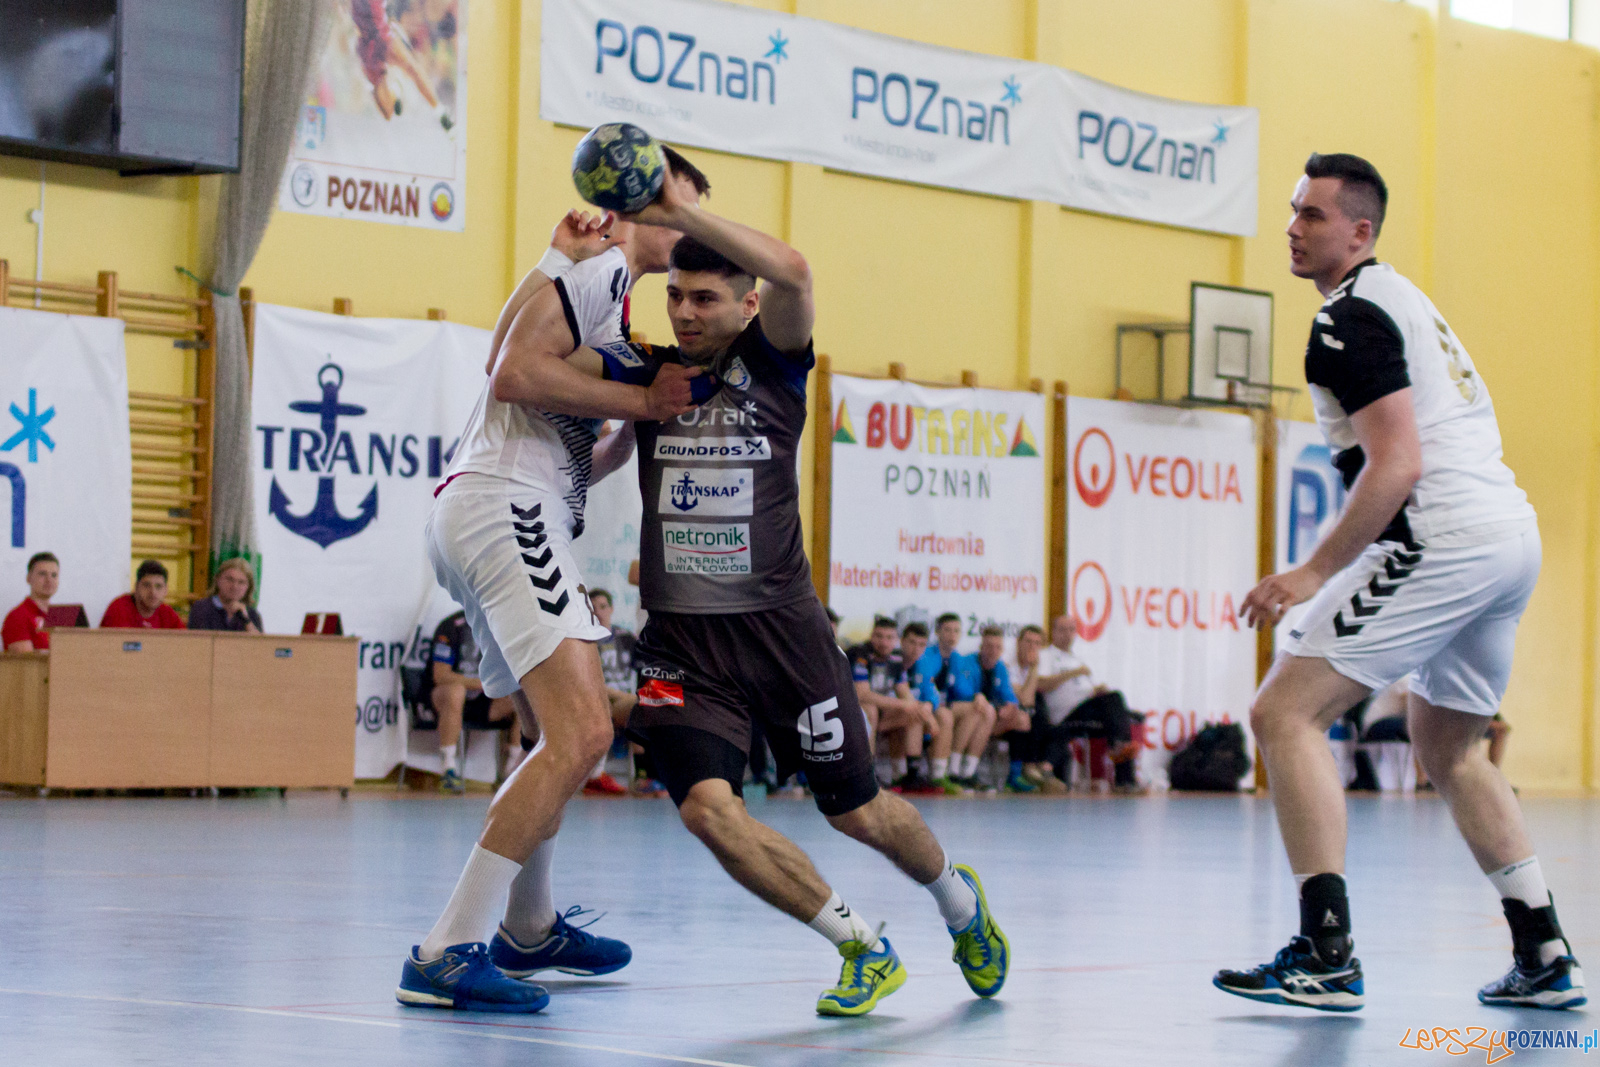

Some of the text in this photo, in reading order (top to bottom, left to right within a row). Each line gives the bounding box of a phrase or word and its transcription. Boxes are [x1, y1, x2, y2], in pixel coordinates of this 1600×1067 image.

[327, 175, 420, 219] POZNAŃ
[865, 402, 1008, 458] BUTRANS
[659, 445, 742, 456] GRUNDFOS
[670, 484, 740, 498] TRANSKAP
[885, 462, 992, 499] POZNAŃ
[1125, 453, 1243, 504] VEOLIA
[665, 527, 745, 546] netronik
[898, 528, 985, 557] Hurtownia
[667, 563, 748, 572] ŚWIATŁOWÓD
[676, 556, 736, 565] INTERNET
[928, 565, 1038, 600] Budowlanych
[1119, 586, 1241, 633] VEOLIA
[797, 696, 844, 752] 15
